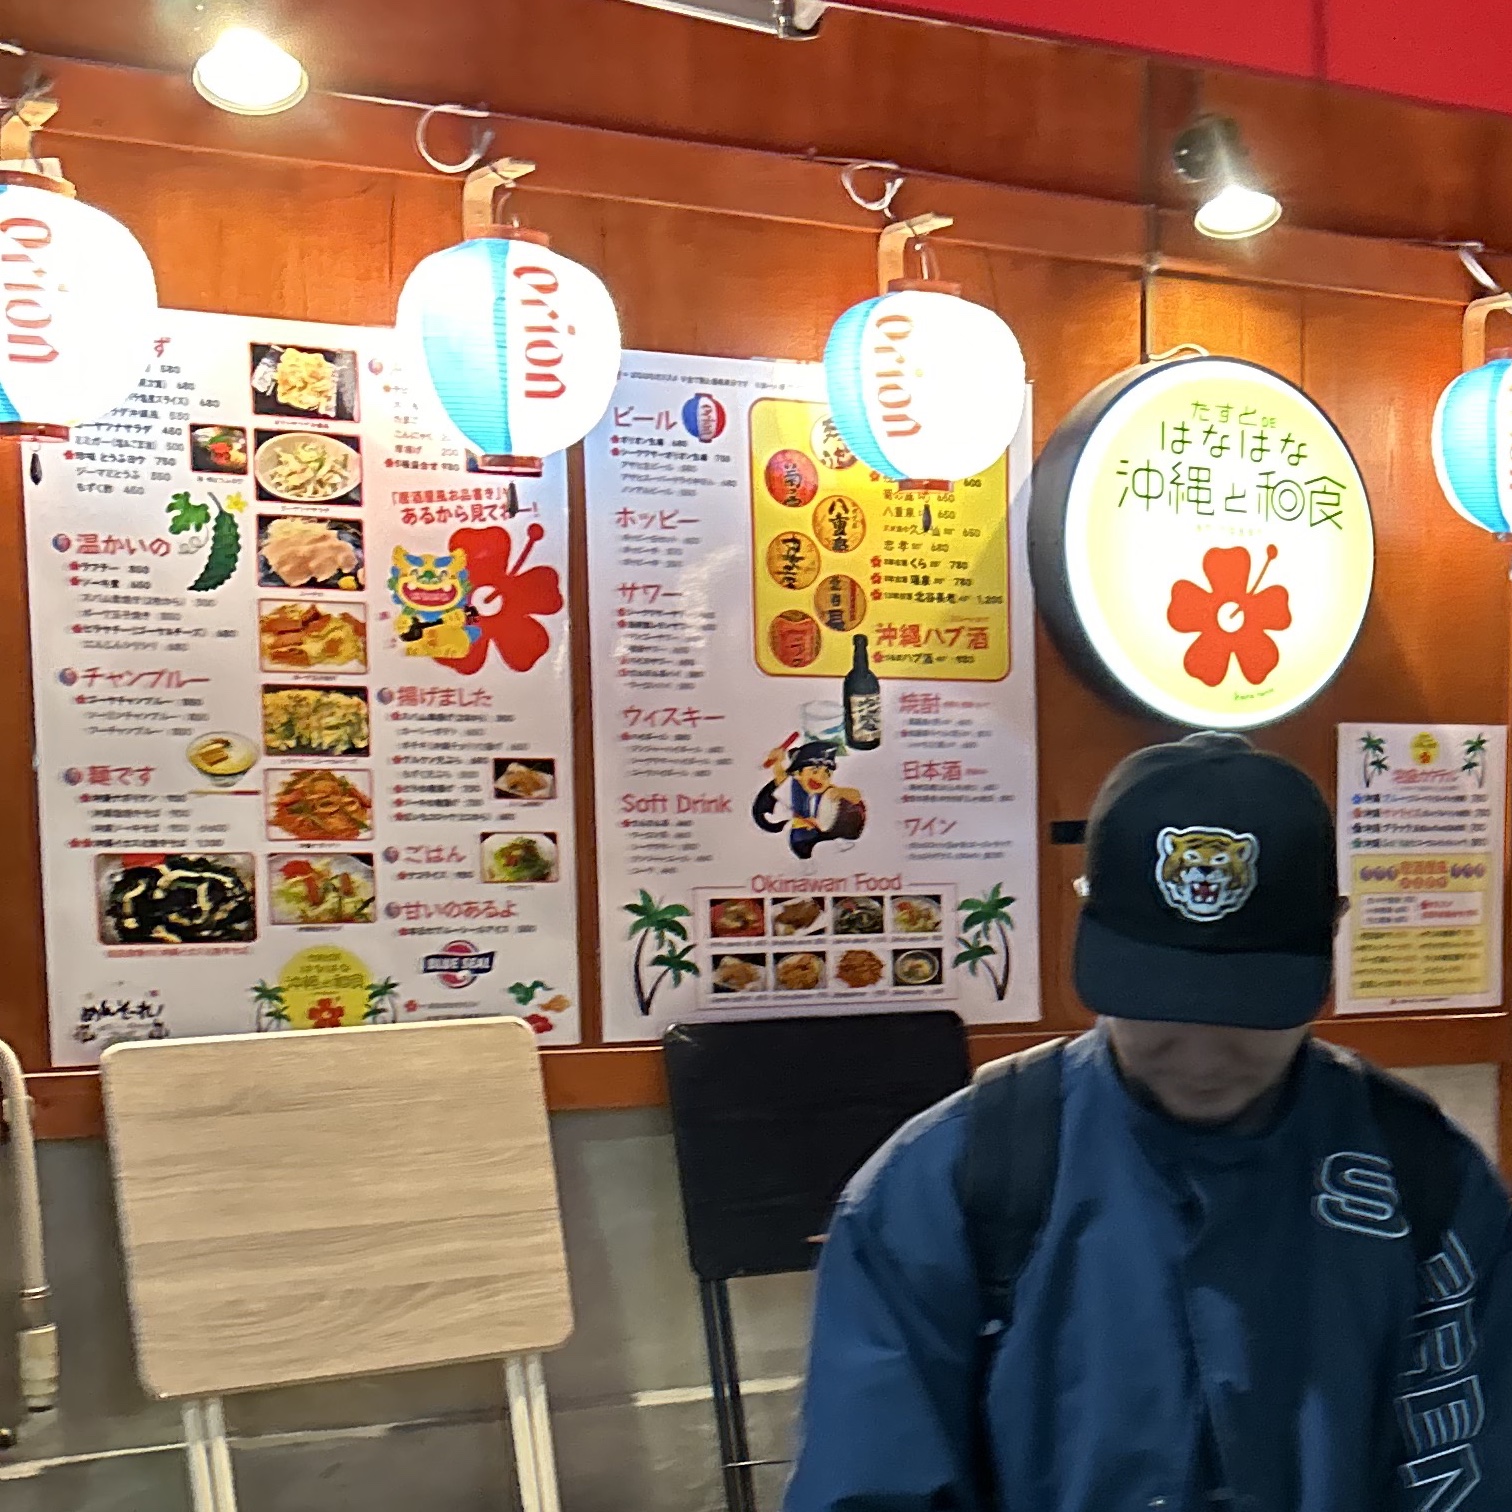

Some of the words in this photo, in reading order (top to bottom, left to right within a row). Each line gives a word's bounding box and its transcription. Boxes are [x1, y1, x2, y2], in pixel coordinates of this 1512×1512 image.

[0, 218, 69, 363] Orion
[513, 266, 576, 399] Orion
[874, 315, 923, 437] Orion
[614, 406, 677, 430] ビール
[1161, 421, 1308, 466] はなはな
[1116, 459, 1347, 530] 沖縄と和食
[615, 508, 700, 529] ホッピー
[77, 533, 171, 556] 温かいの
[617, 582, 683, 603] サワー
[875, 622, 990, 650] 沖縄ハブ酒
[81, 667, 210, 688] チャンプルー
[395, 686, 493, 707] 揚げました
[622, 706, 726, 728] ウィスキー
[903, 760, 962, 781] 日本酒
[621, 793, 668, 813] Soft
[676, 794, 732, 814] Drink
[904, 817, 957, 837] ワイン
[404, 845, 466, 863] ごはん
[752, 873, 848, 893] Okinawan
[854, 873, 903, 891] Food
[401, 899, 517, 920] 甘いのあるよ
